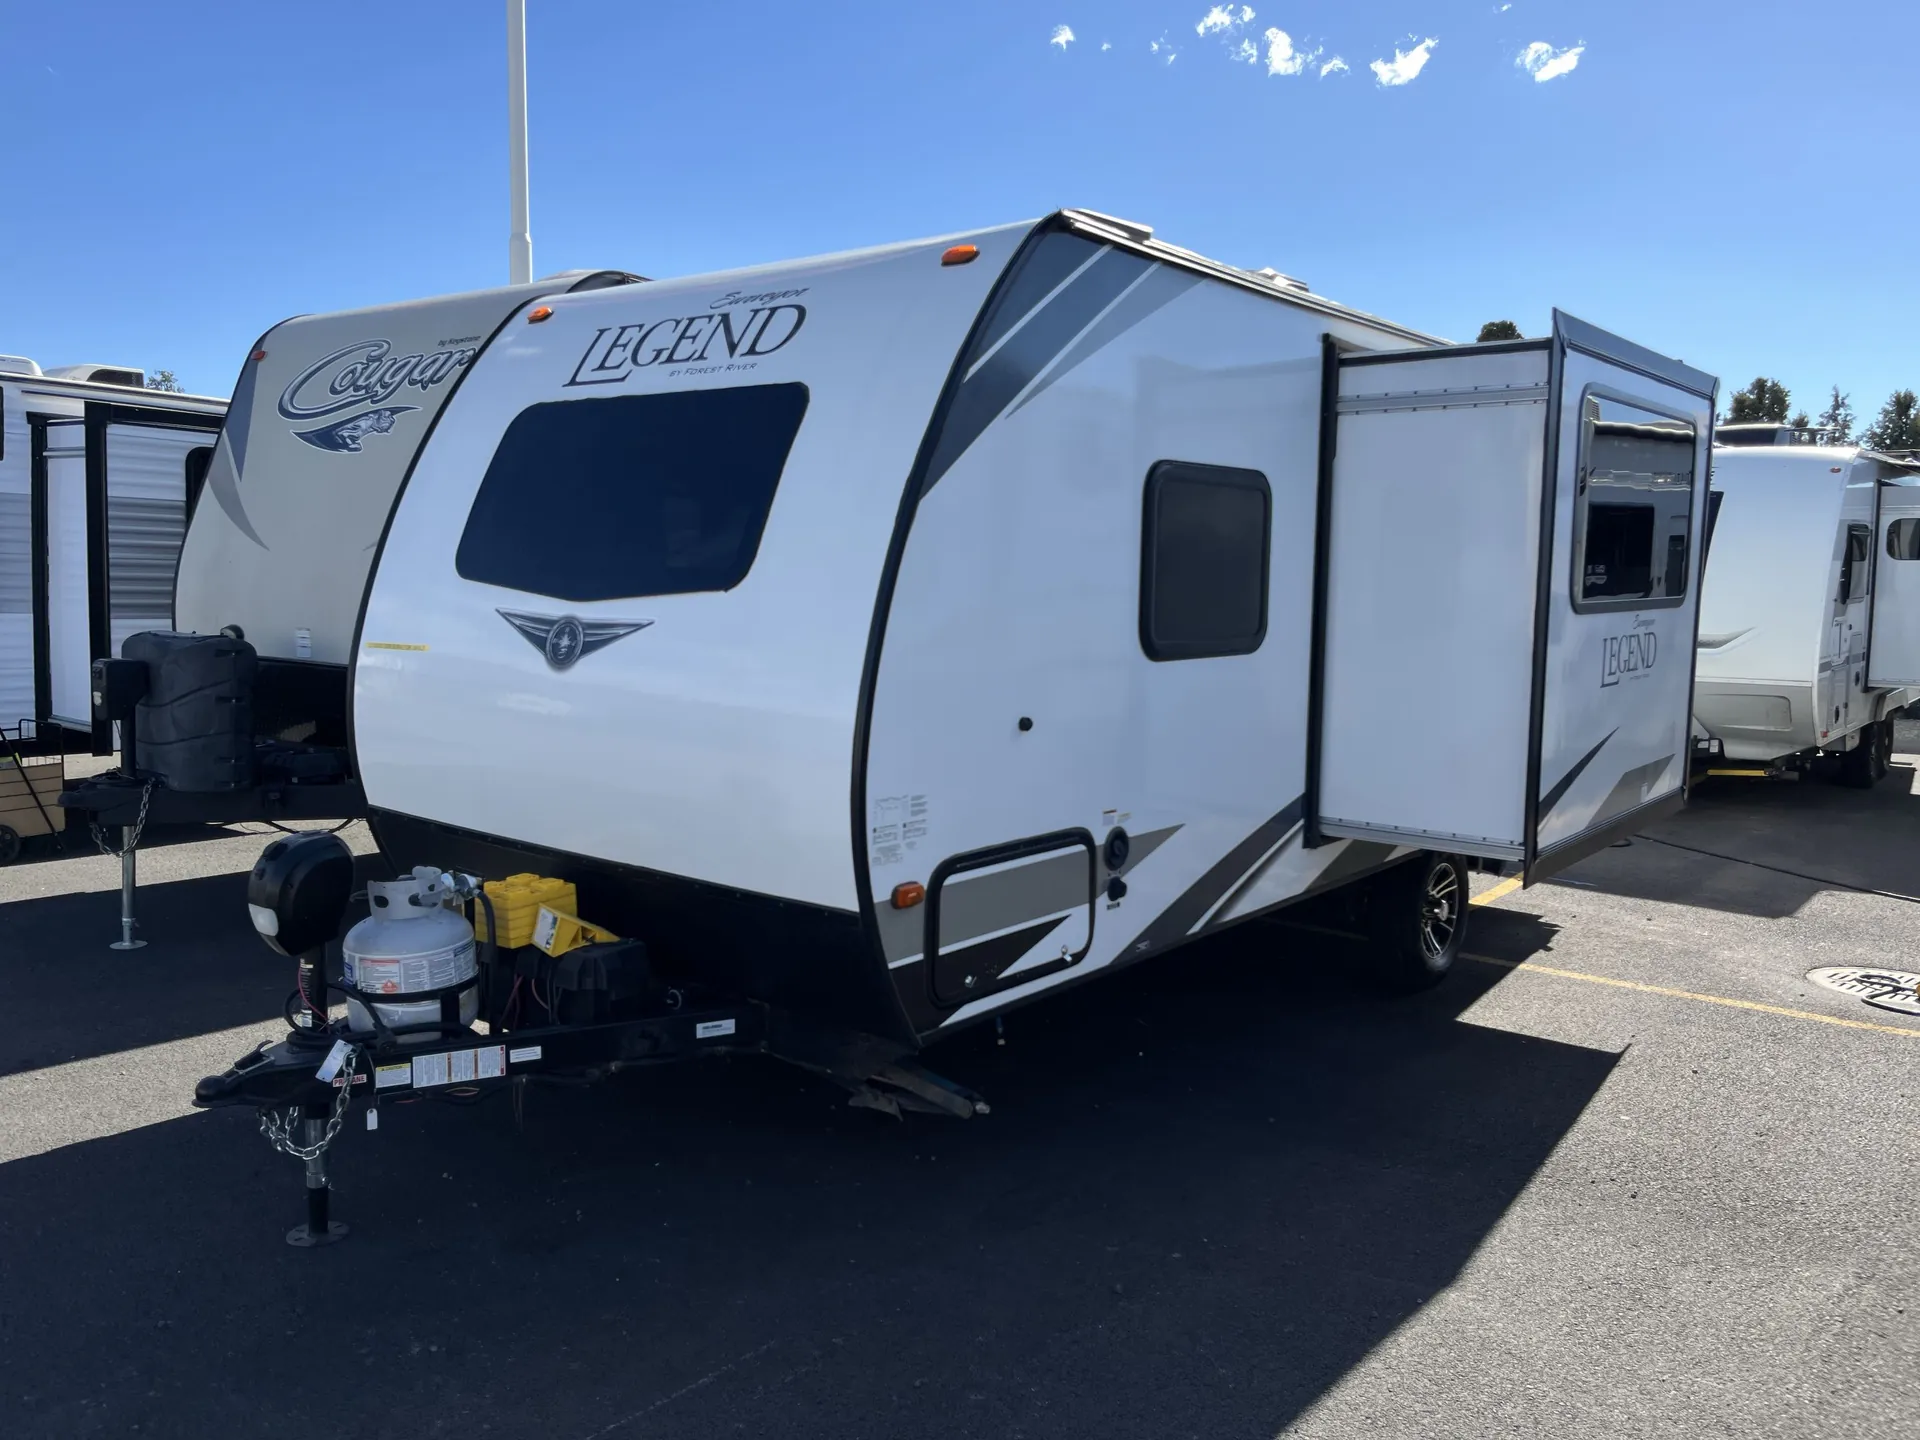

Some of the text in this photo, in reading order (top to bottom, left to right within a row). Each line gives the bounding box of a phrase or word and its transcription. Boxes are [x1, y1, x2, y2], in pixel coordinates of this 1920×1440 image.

[561, 303, 808, 388] LEGEND
[684, 366, 724, 376] FOREST
[725, 363, 757, 372] RIVER
[277, 338, 477, 421] Cougar
[1600, 632, 1657, 688] LEGEND
[333, 1075, 365, 1086] PRANE
